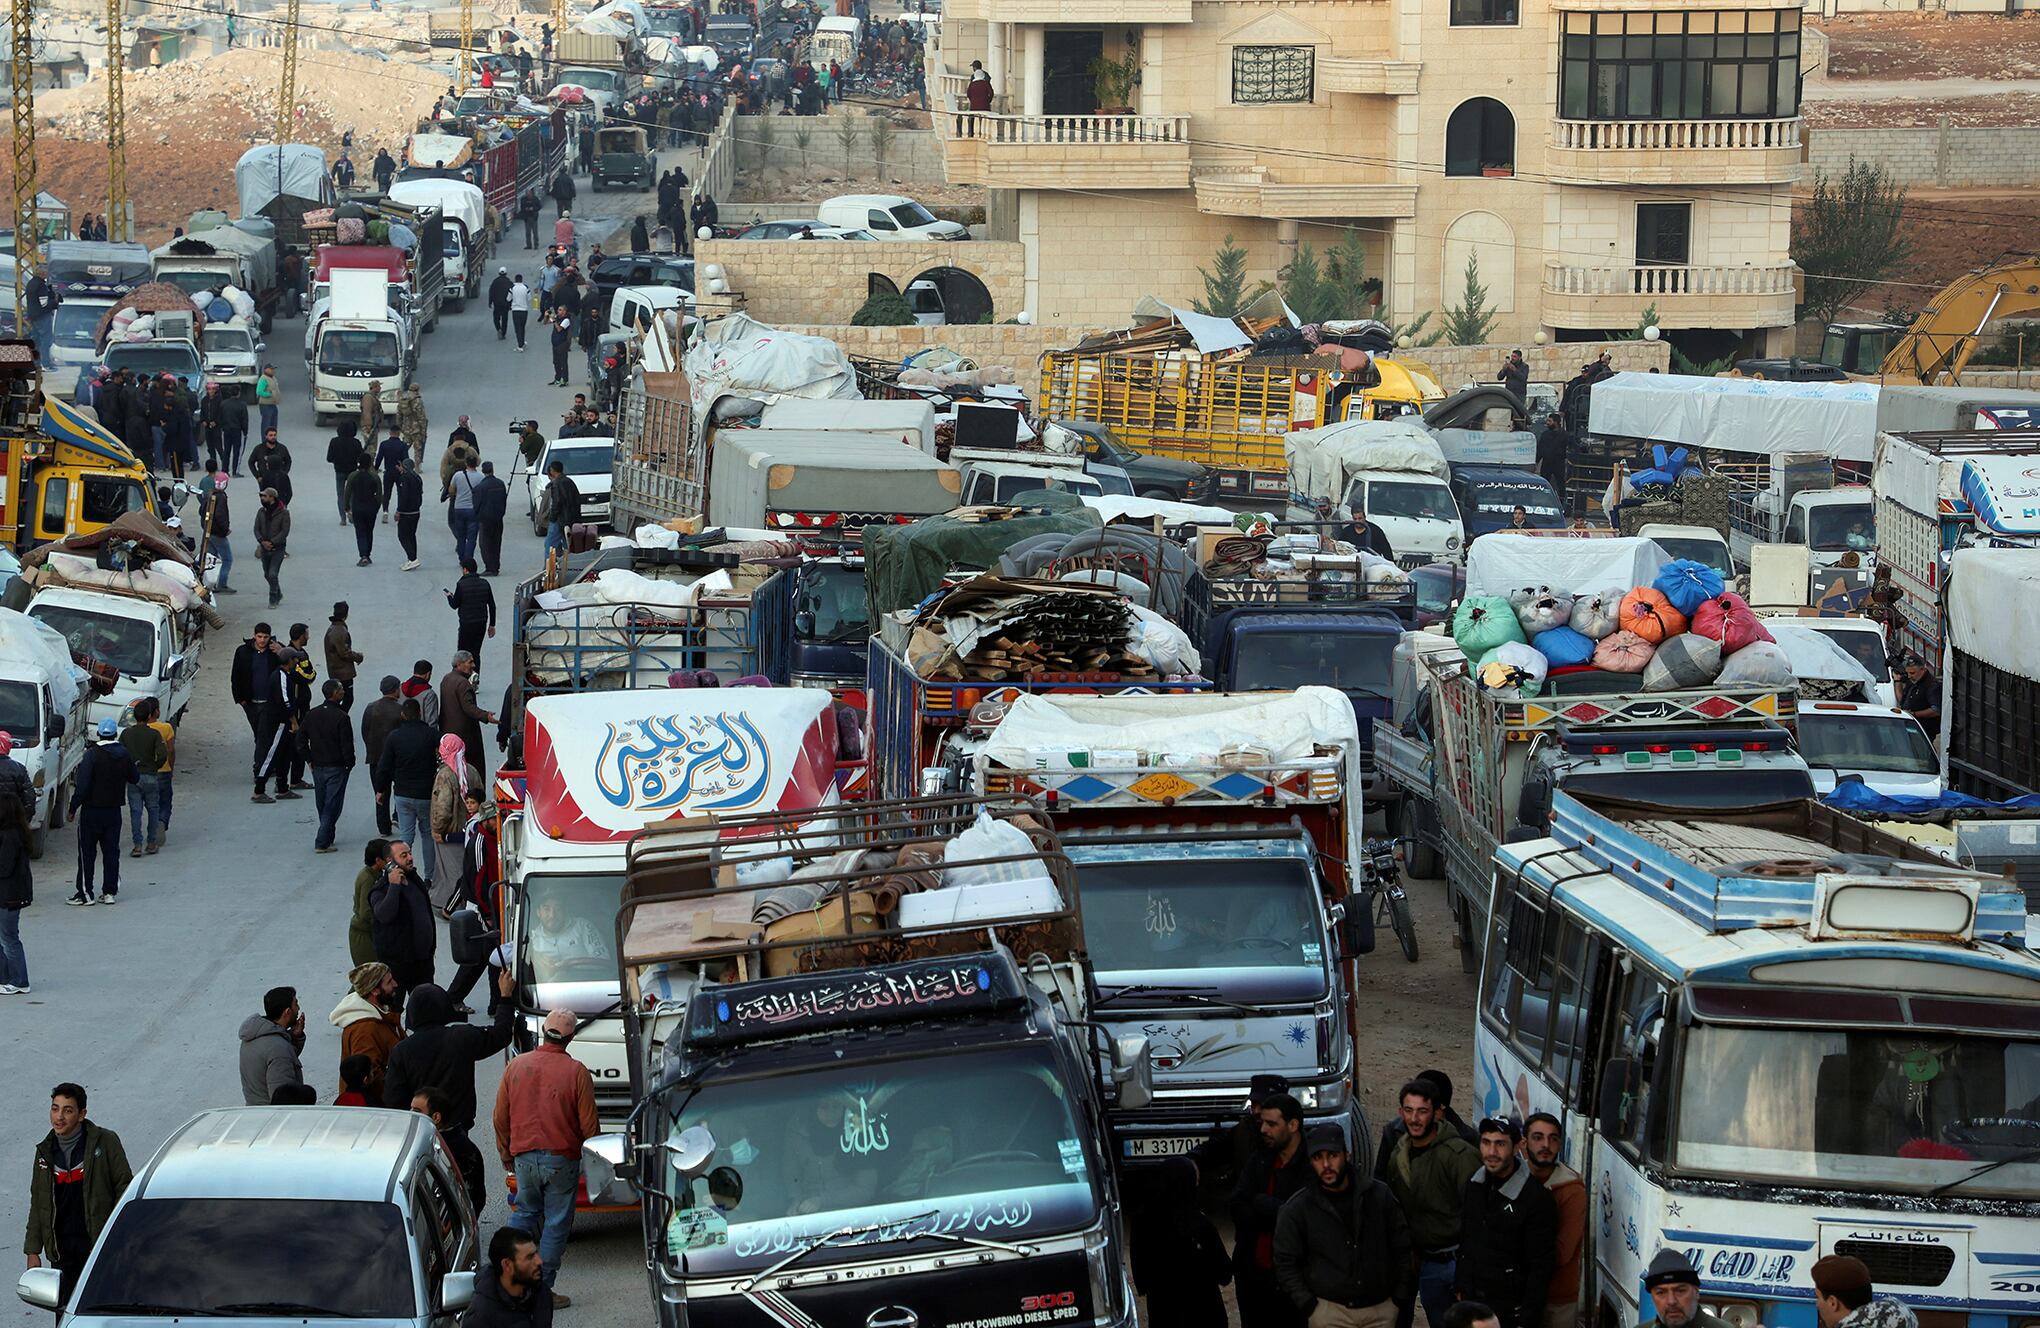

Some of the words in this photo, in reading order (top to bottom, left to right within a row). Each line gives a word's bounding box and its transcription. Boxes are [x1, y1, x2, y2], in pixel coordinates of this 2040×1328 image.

[846, 976, 901, 1011] الله
[588, 1068, 621, 1078] NO
[1133, 1141, 1145, 1155] M
[1848, 1232, 1893, 1241] الله
[1021, 1292, 1075, 1311] 300
[976, 1314, 1023, 1328] POWERING
[1024, 1310, 1052, 1323] DIESEL
[1053, 1306, 1079, 1320] SPEED
